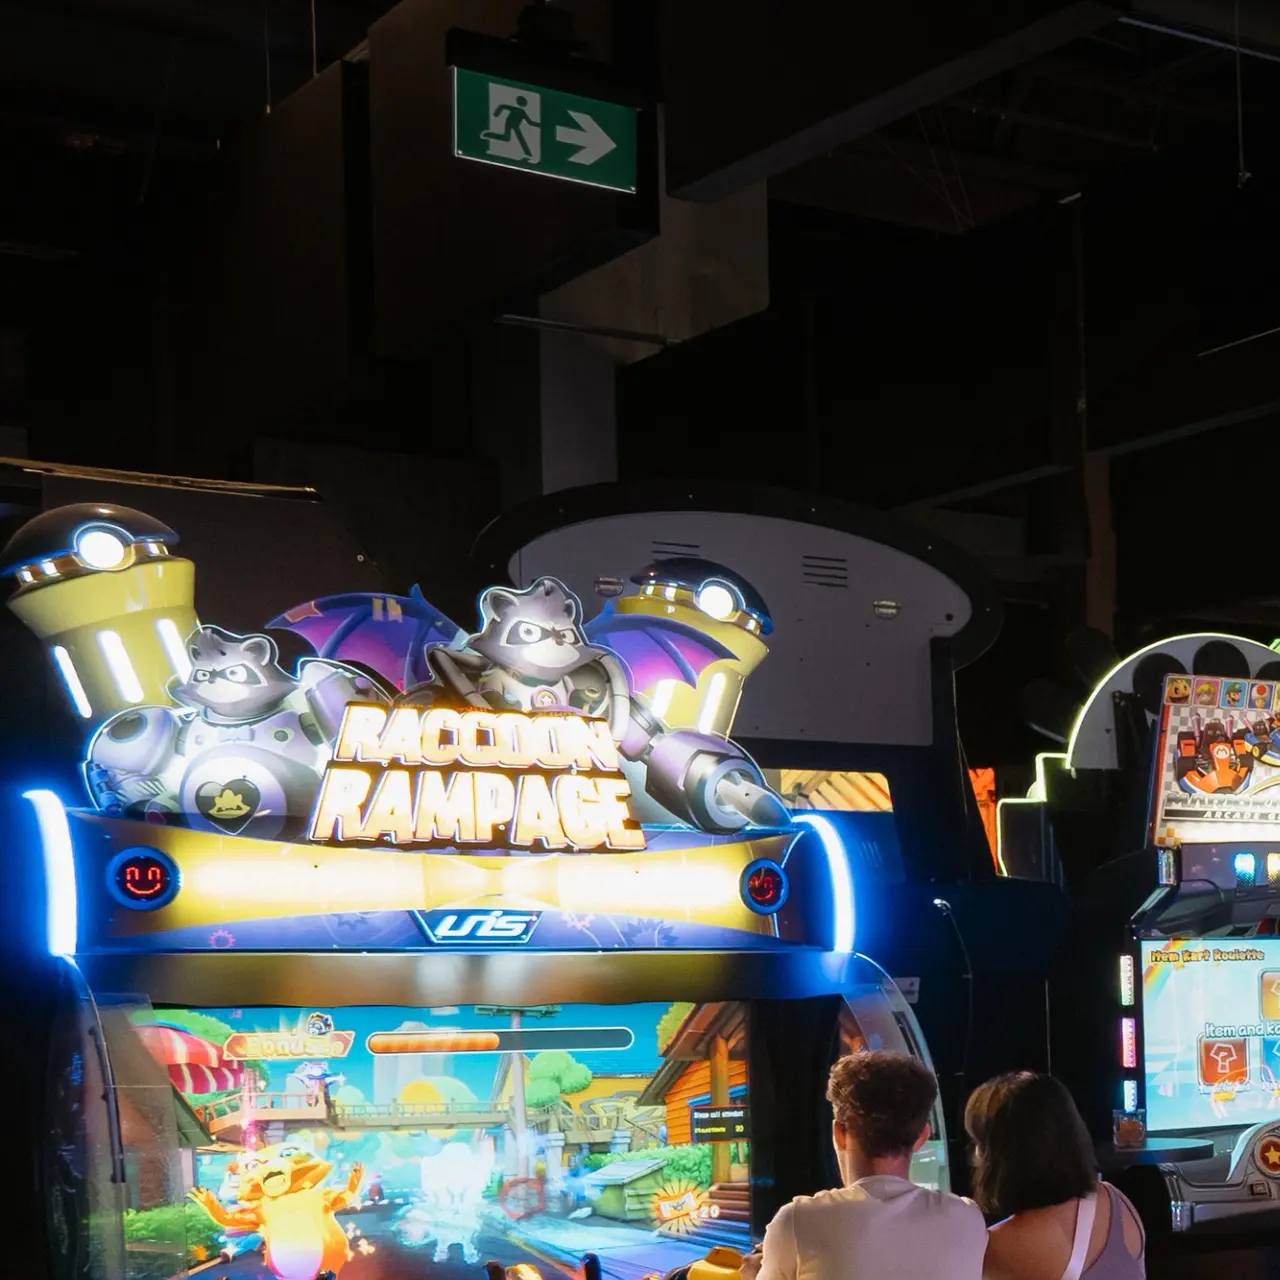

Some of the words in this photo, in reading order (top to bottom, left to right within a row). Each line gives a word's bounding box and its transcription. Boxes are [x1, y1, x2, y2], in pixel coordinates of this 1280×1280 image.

[335, 701, 621, 771] RACCOON
[310, 766, 647, 852] RAMPAGE
[1151, 950, 1179, 962] Item
[1182, 949, 1210, 962] Kart
[1213, 948, 1264, 962] Roulette
[1204, 1022, 1239, 1038] Item
[1239, 1021, 1265, 1037] and
